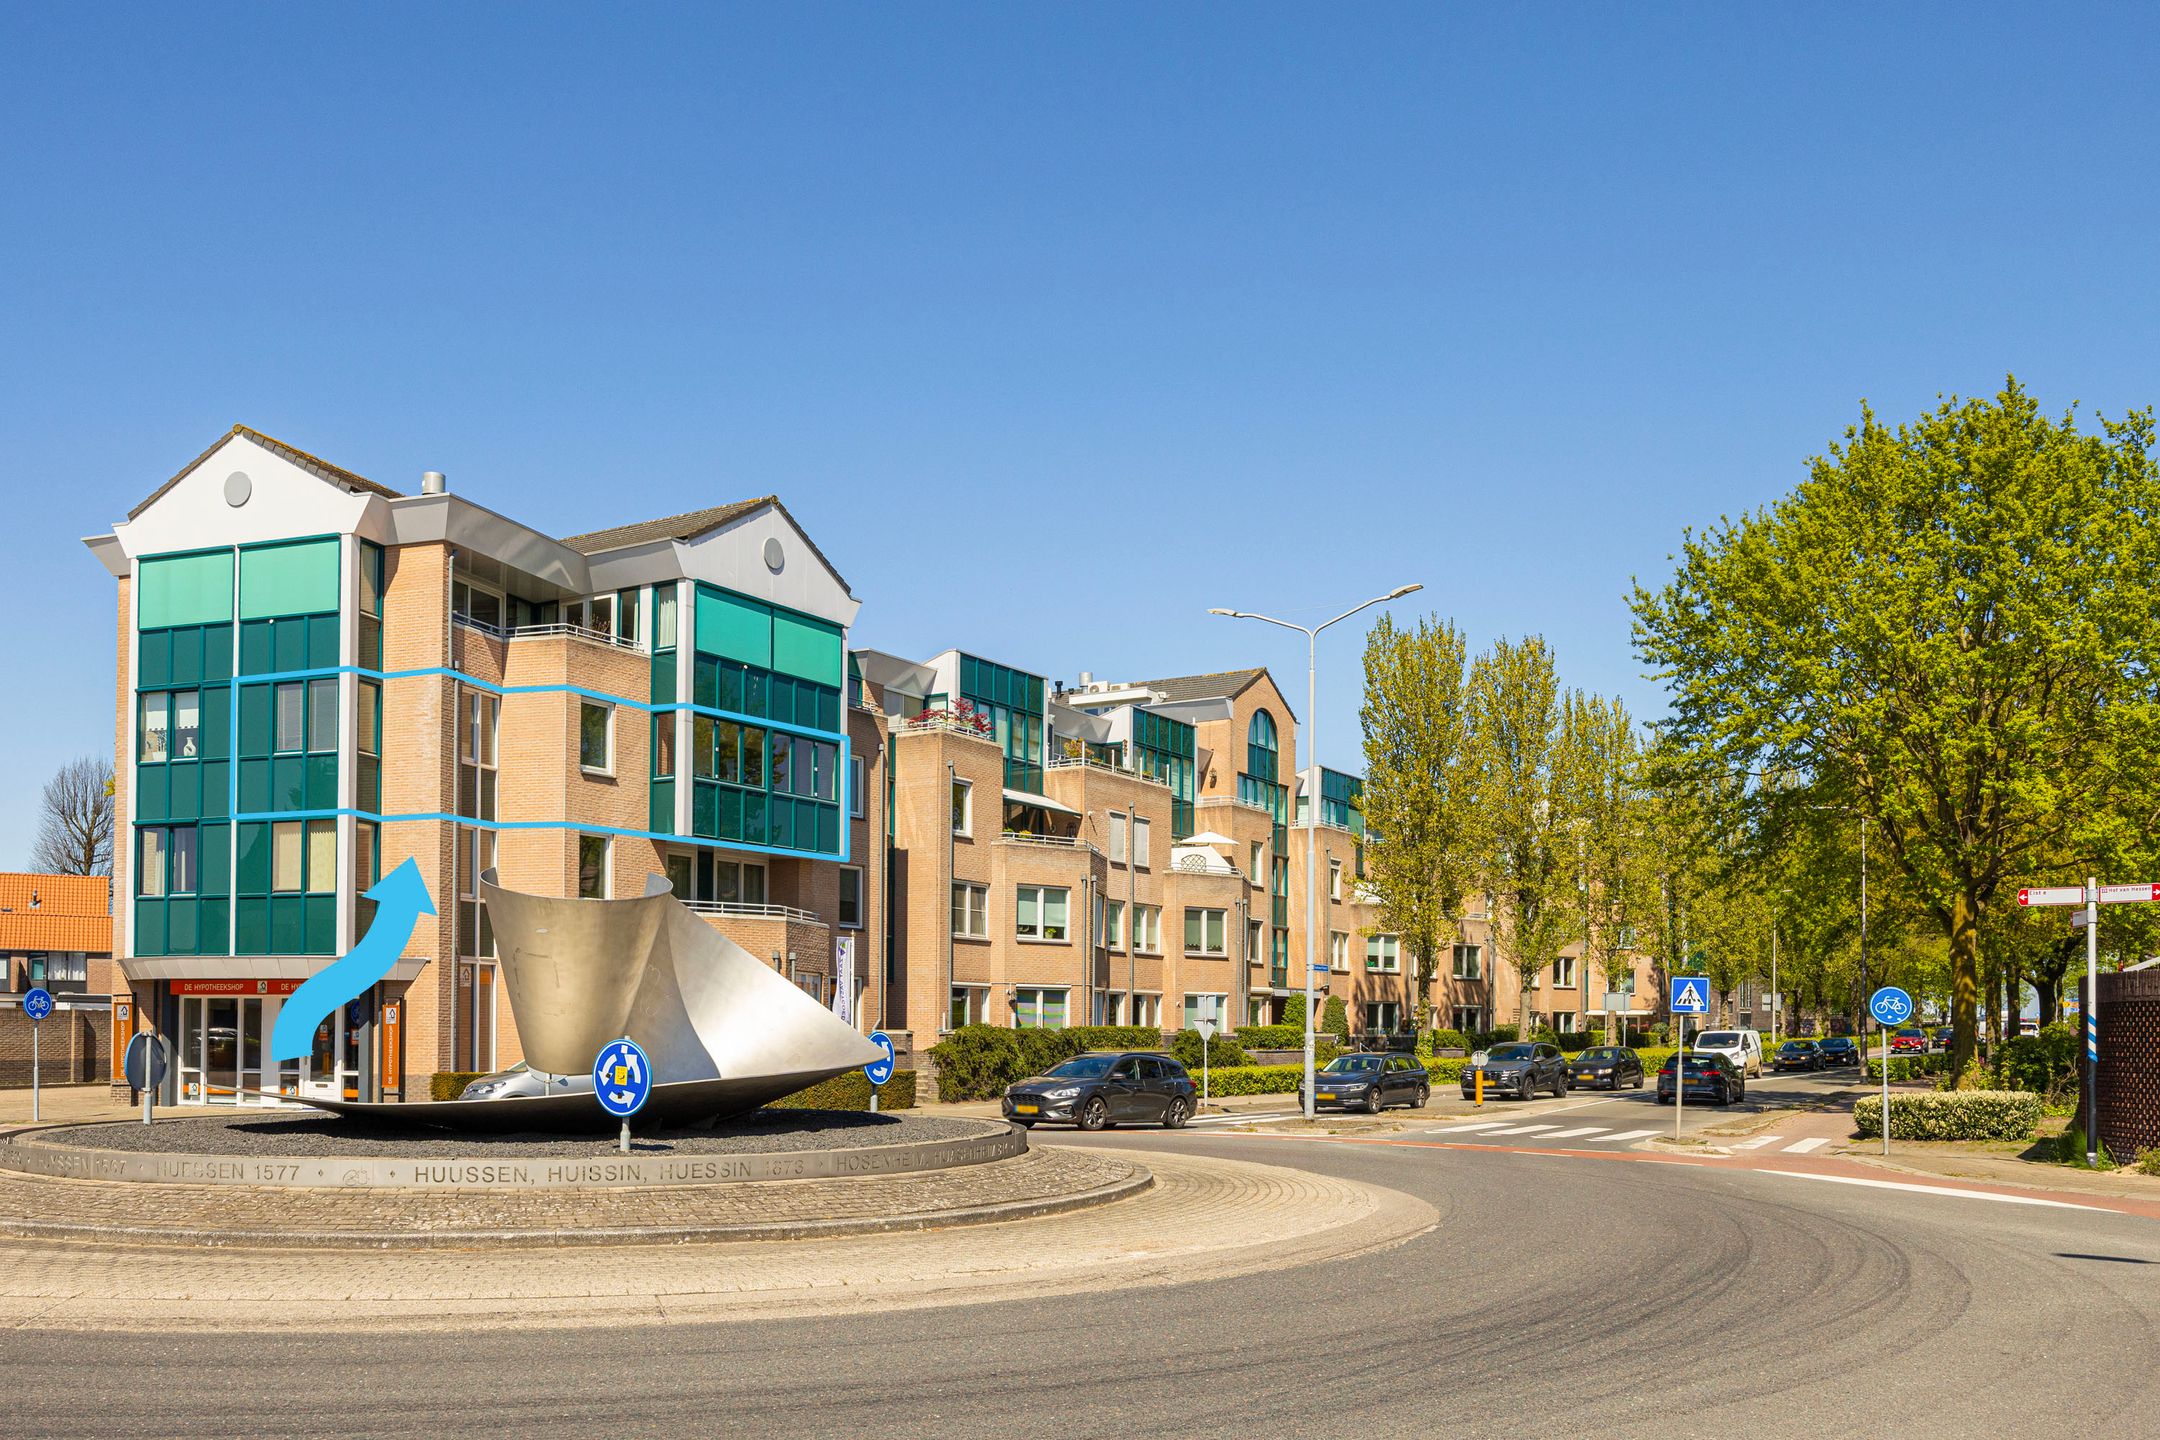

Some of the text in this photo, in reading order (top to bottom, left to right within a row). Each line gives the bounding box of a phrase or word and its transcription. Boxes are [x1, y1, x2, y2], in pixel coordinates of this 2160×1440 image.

[184, 983, 244, 991] DE HYPOTHEEKSHOP
[280, 983, 289, 991] DE
[387, 1076, 393, 1085] DE
[96, 1158, 127, 1175] 1567
[156, 1161, 300, 1181] HUESSEN 1577
[415, 1166, 535, 1185] HUUSSEN,
[548, 1164, 648, 1183] HUISSIN,
[660, 1161, 752, 1180] HUESSIN
